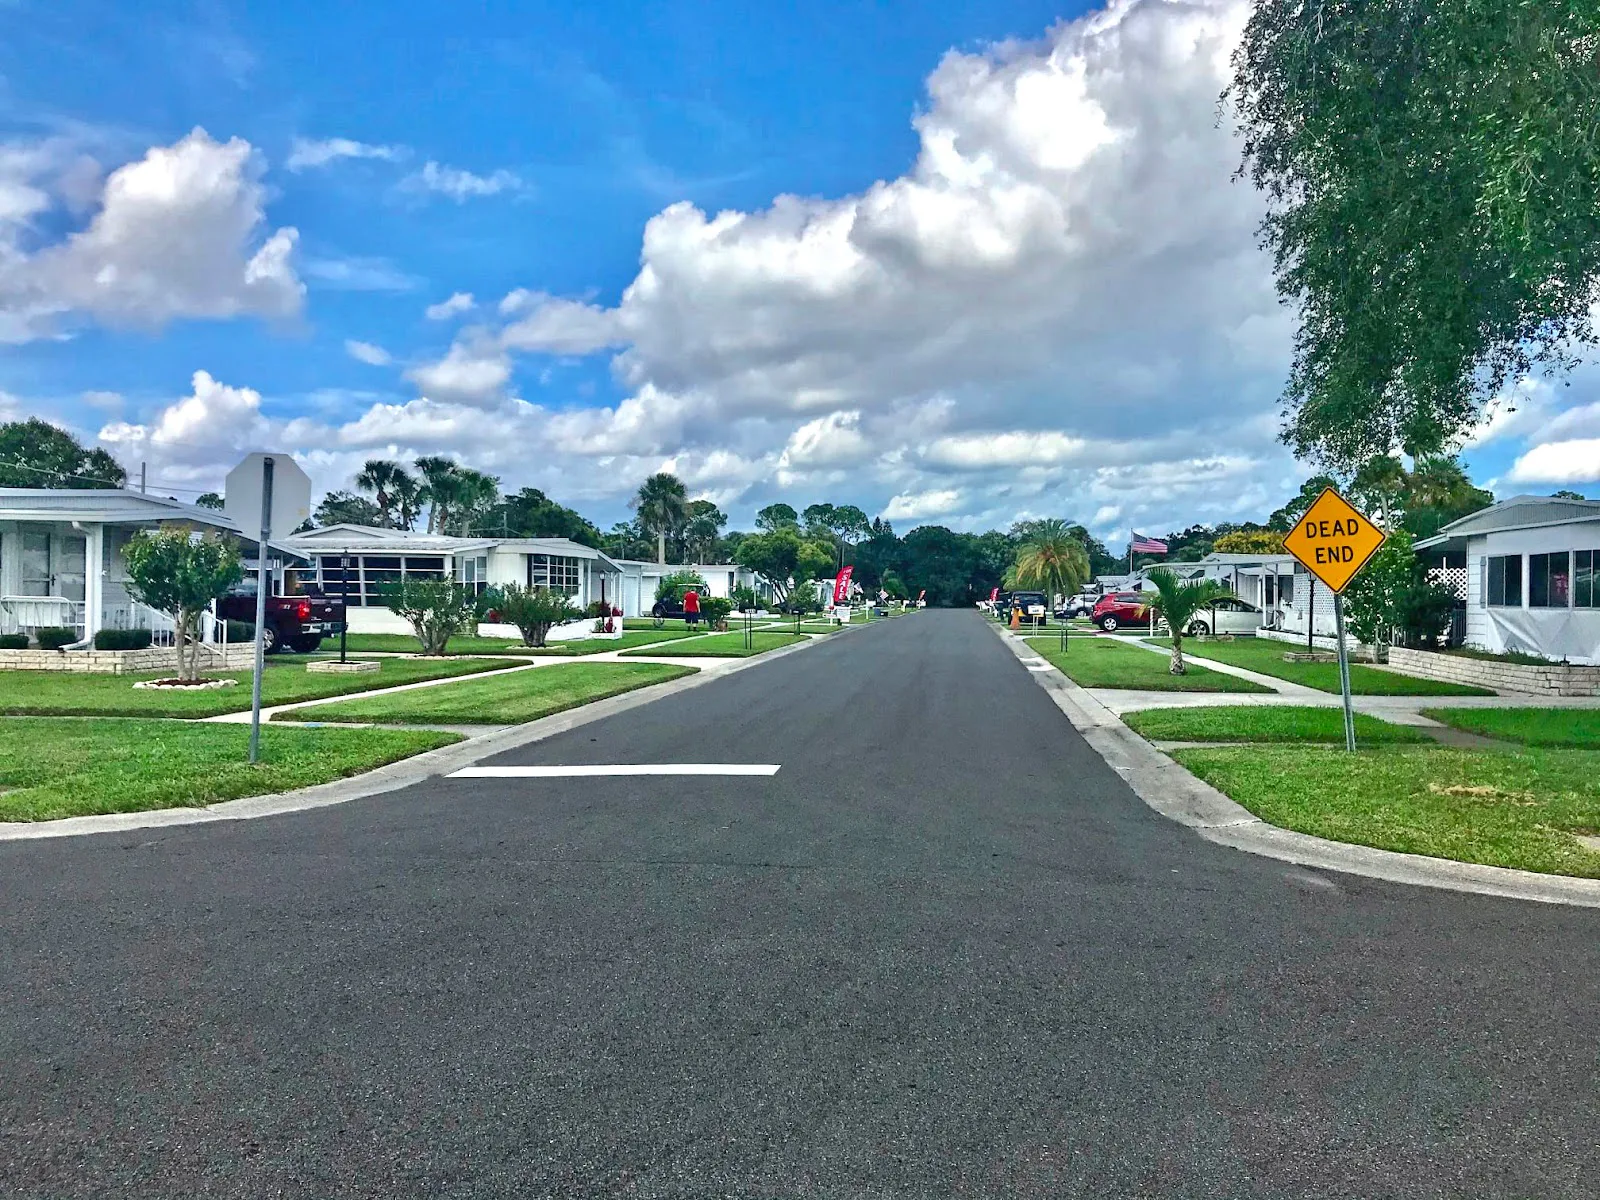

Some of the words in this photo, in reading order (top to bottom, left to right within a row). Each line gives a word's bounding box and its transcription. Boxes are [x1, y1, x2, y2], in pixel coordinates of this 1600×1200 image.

[1306, 519, 1358, 538] DEAD
[1316, 546, 1353, 563] END
[838, 574, 849, 600] SALE
